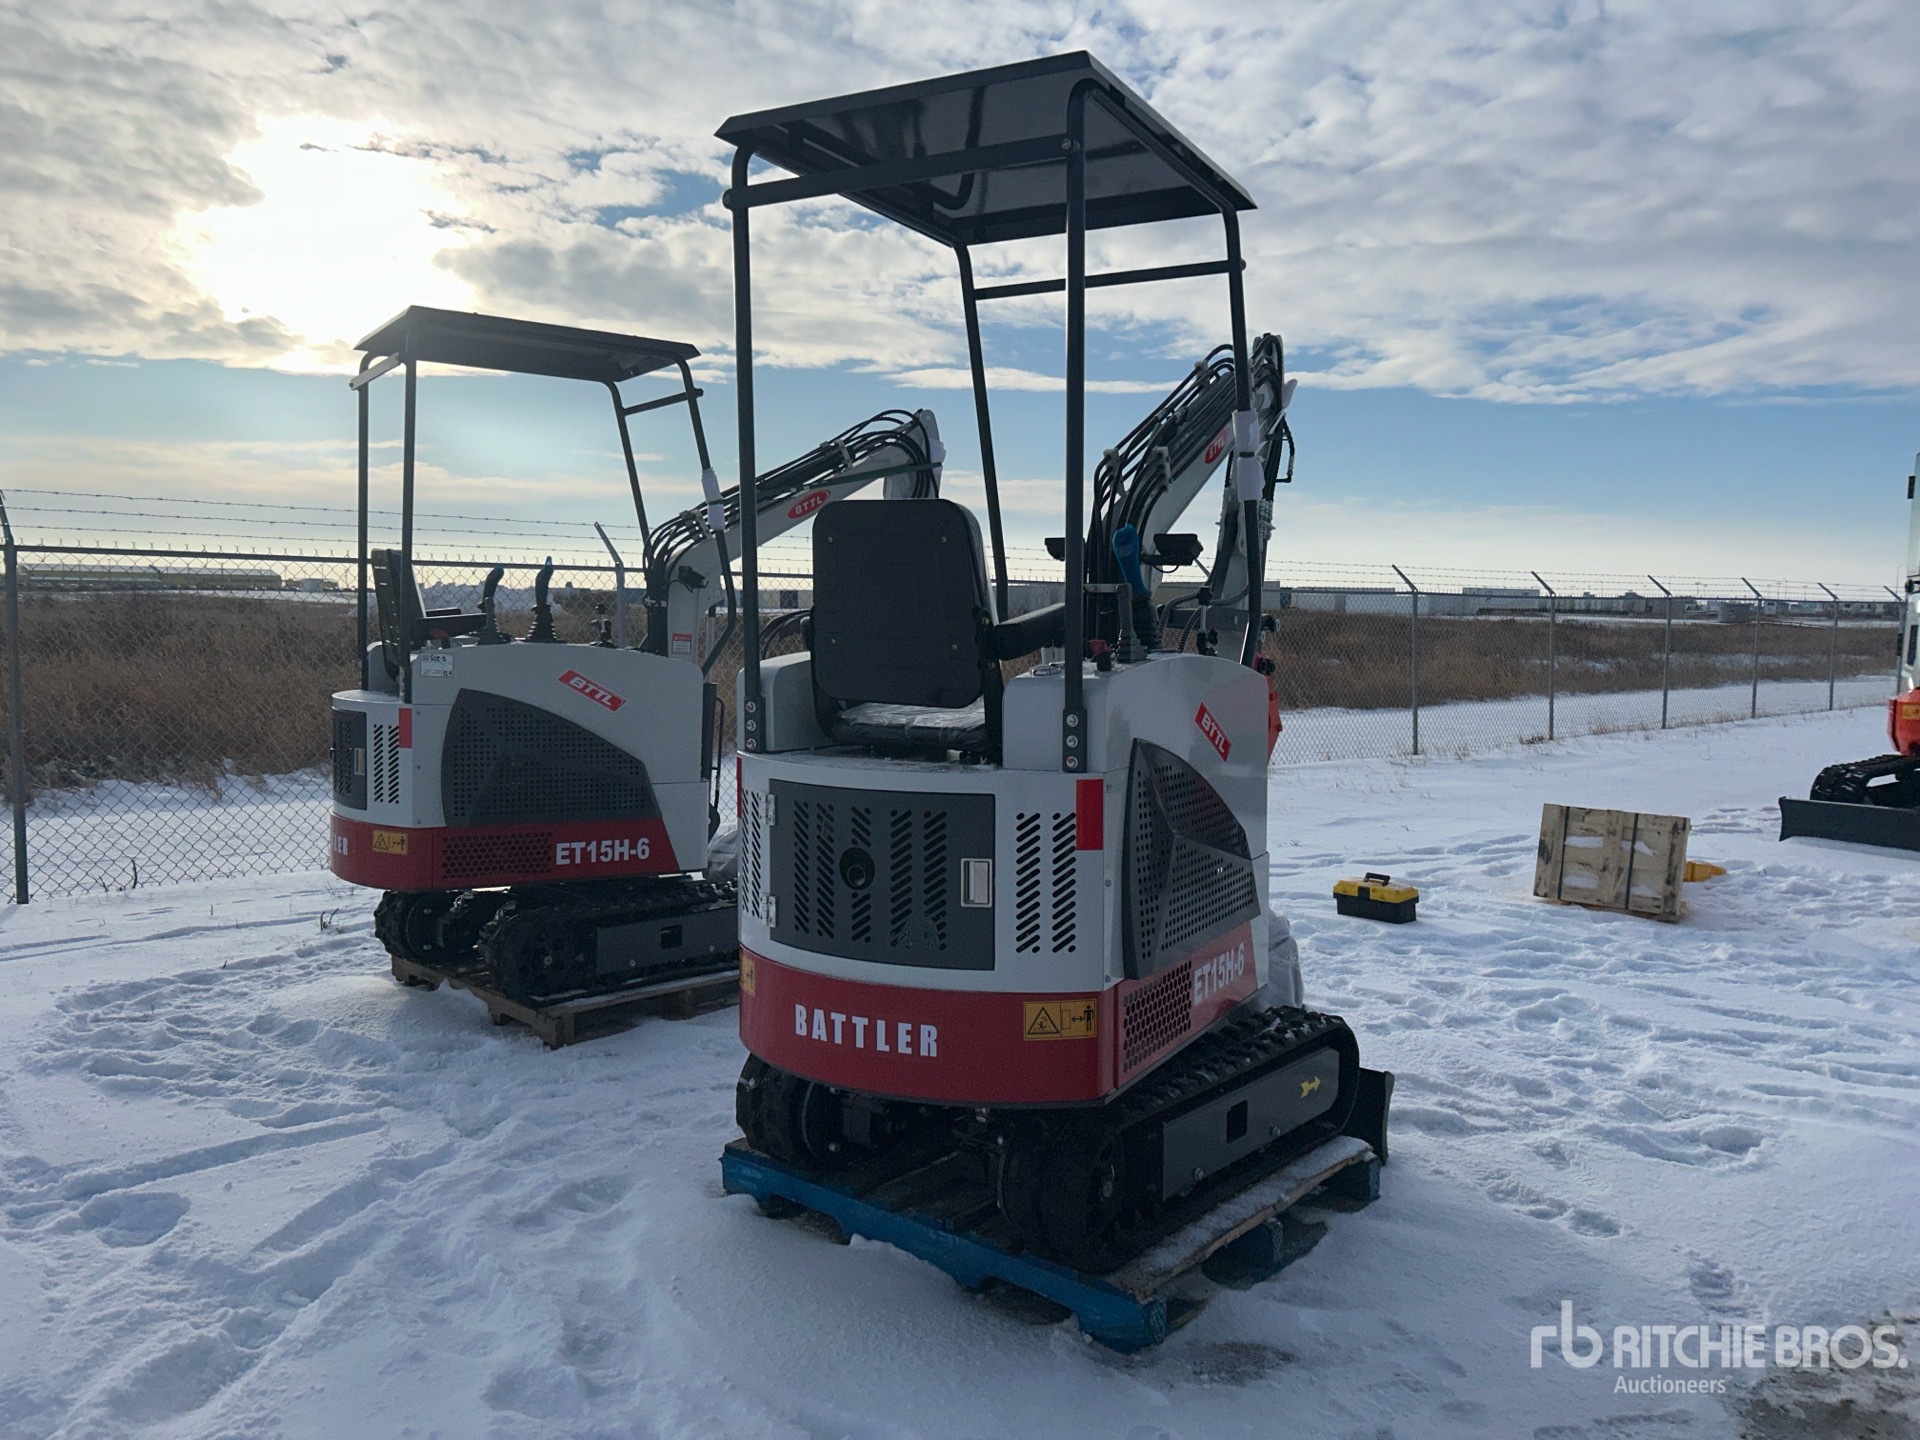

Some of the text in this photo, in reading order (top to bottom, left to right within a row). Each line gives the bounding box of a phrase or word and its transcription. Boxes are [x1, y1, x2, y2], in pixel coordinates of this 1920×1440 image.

[795, 496, 823, 515] BTTL
[569, 676, 613, 706] BTTL
[1201, 712, 1225, 753] BTTL
[556, 837, 650, 866] ET15H-6
[1194, 942, 1245, 1006] ET15H-6
[795, 1003, 938, 1057] BATTLER
